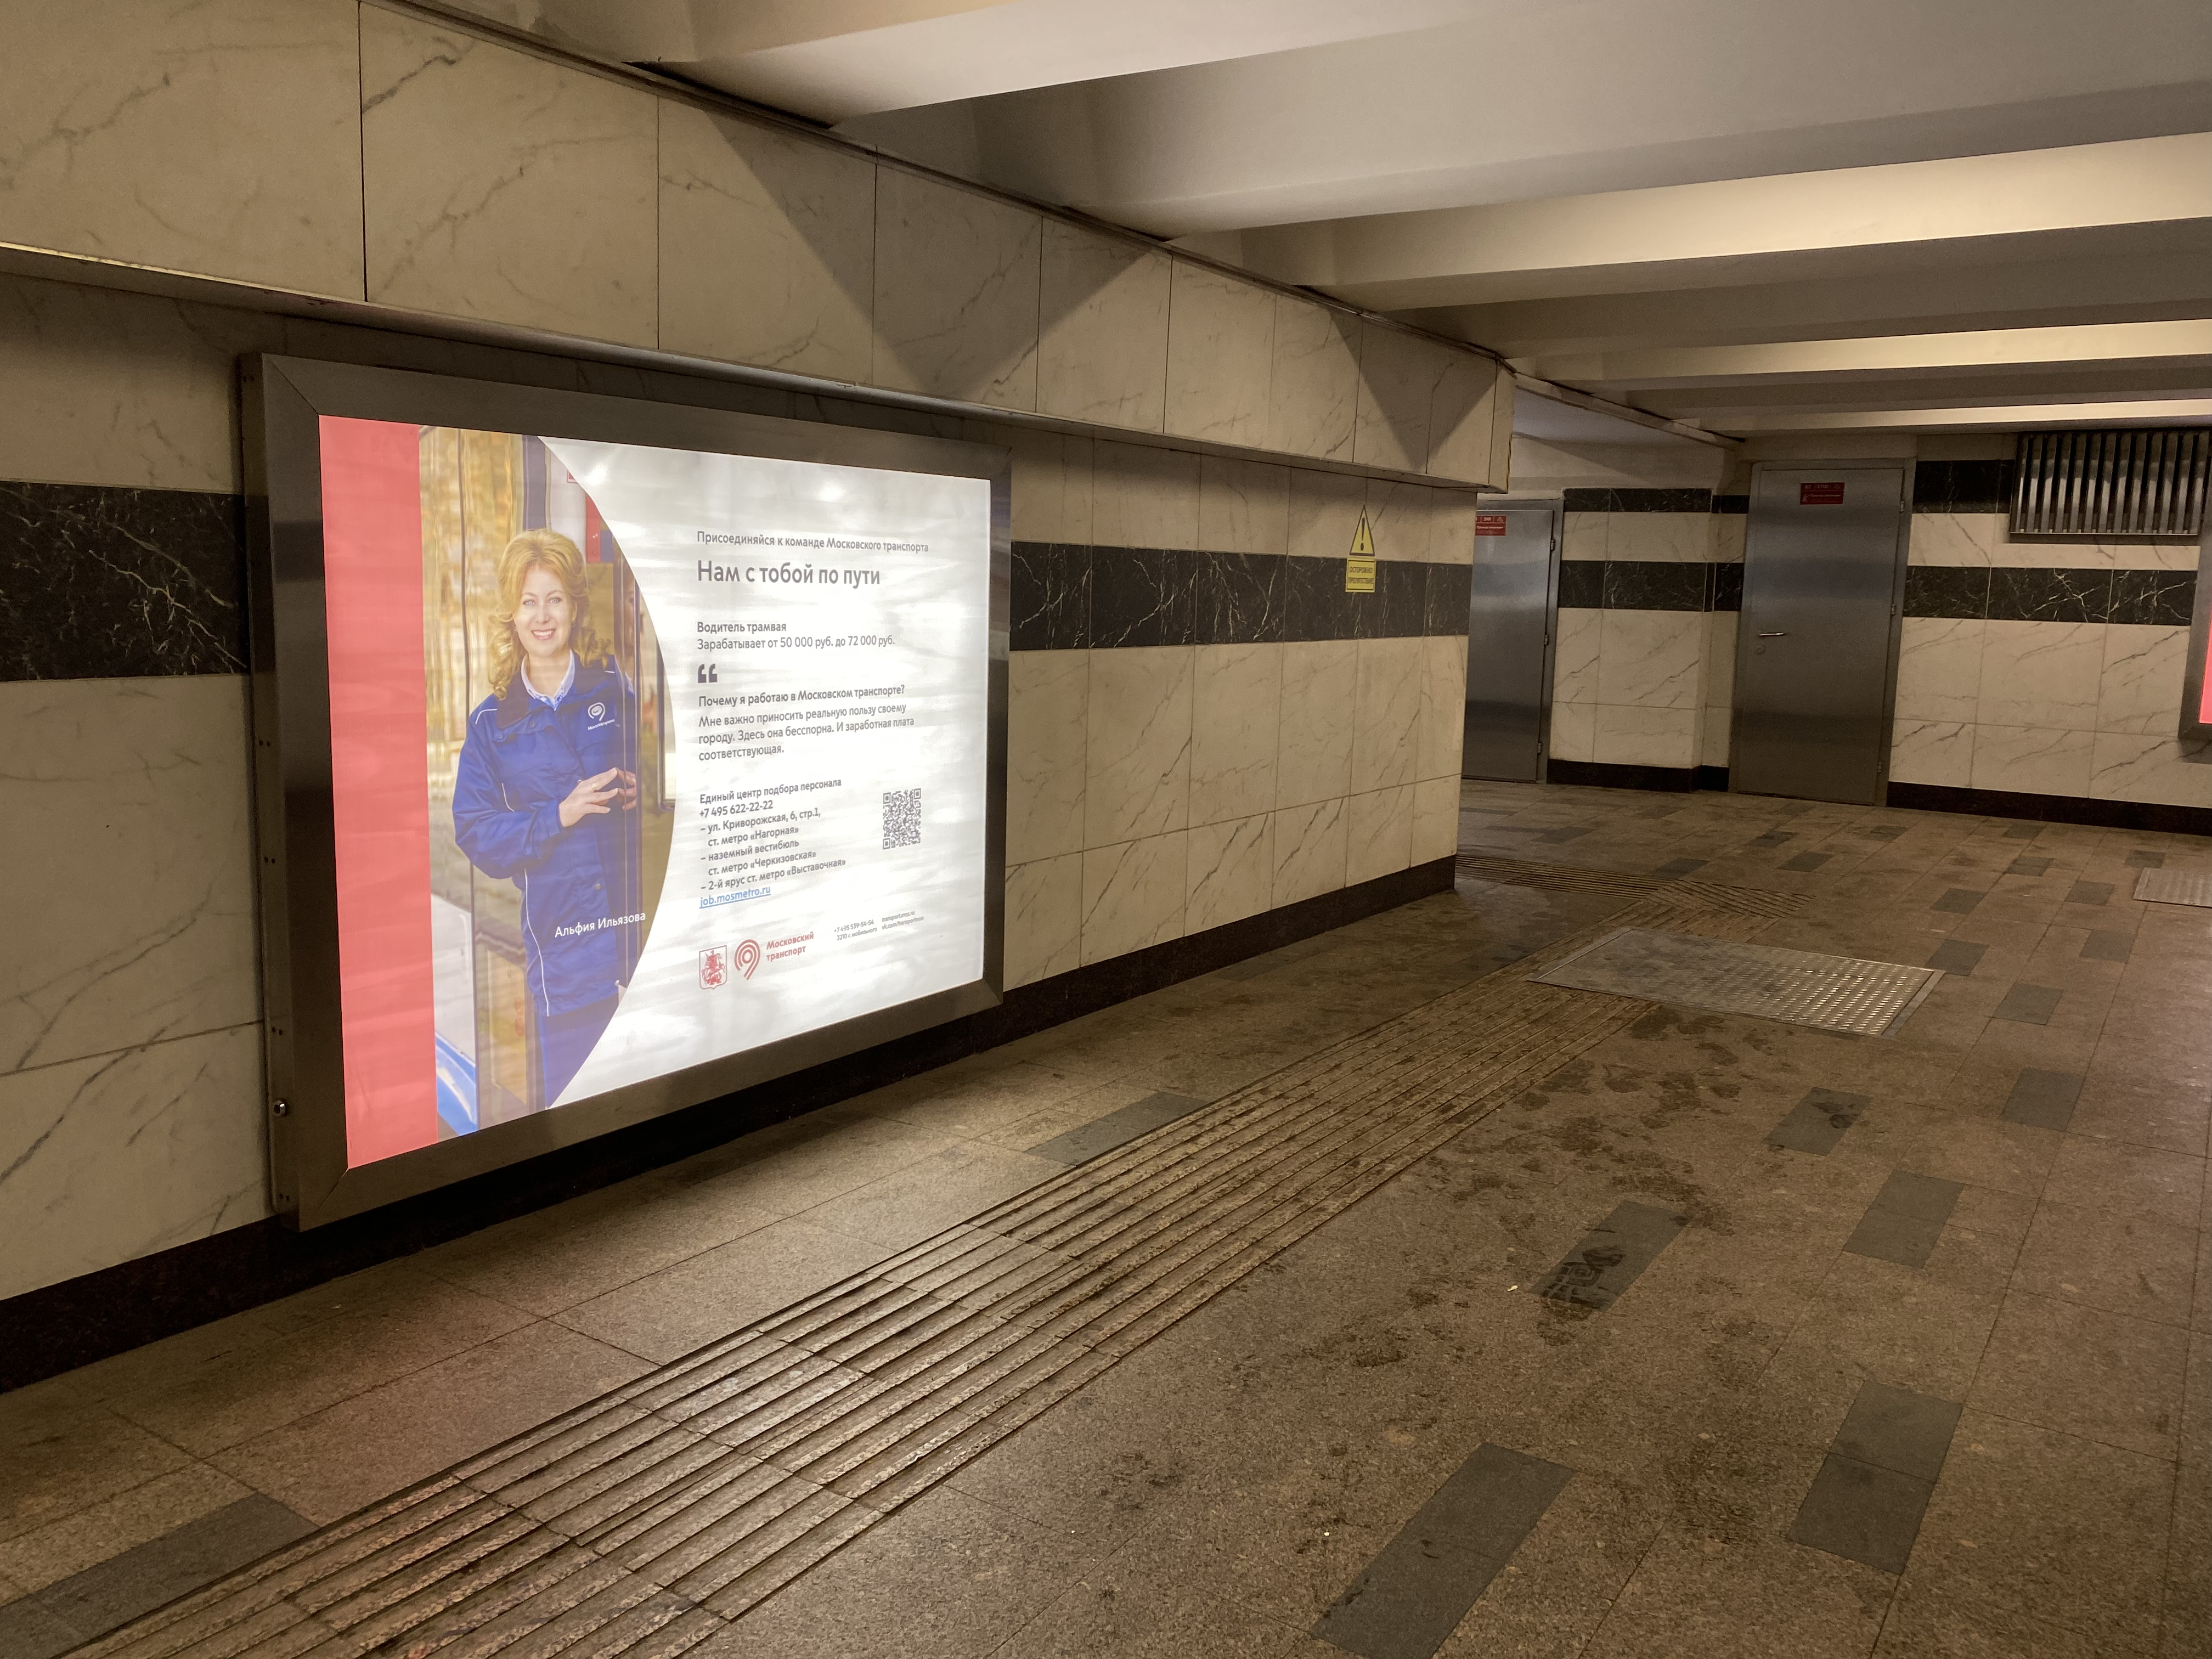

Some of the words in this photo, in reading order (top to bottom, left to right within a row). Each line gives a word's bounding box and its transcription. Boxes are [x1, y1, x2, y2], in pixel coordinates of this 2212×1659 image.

[697, 531, 775, 546] Присоединяйся
[777, 537, 784, 546] к
[785, 538, 825, 550] команде
[826, 537, 882, 550] Московского
[882, 543, 929, 554] транспорта
[697, 560, 741, 583] Нам
[745, 567, 755, 583] с
[759, 562, 814, 584] тобой
[819, 569, 839, 584] по
[843, 569, 880, 589] пути
[697, 621, 746, 635] Водитель
[746, 623, 787, 635] трамвая
[697, 637, 766, 652] Зарабатывает
[768, 640, 778, 648] от
[780, 636, 792, 648] 50
[794, 636, 813, 647] 000
[815, 635, 833, 650] руб.
[835, 638, 846, 648] до
[848, 635, 859, 646] 72
[860, 635, 877, 646] 000
[878, 634, 895, 647] руб.
[698, 696, 738, 708] Почему
[739, 696, 746, 705] я
[748, 692, 789, 707] работаю
[790, 693, 796, 702] в
[797, 690, 853, 701] Московском
[854, 684, 905, 699] транспорте?
[698, 715, 722, 727] Мне
[724, 715, 755, 726] важно
[757, 712, 804, 725] приносить
[805, 708, 848, 721] реальную
[849, 706, 877, 716] пользу
[877, 704, 907, 714] своему
[698, 733, 736, 746] городу.
[737, 730, 765, 742] Здесь
[766, 729, 783, 738] она
[785, 725, 834, 737] бесспорна.
[836, 721, 844, 732] И
[845, 719, 891, 733] заработная
[893, 718, 915, 727] плата
[698, 745, 785, 761] соответствующая.
[699, 790, 735, 805] Единый
[736, 789, 762, 800] центр
[764, 783, 799, 796] подбора
[800, 779, 842, 792] персонала
[699, 808, 710, 818] +7
[710, 805, 728, 817] 495
[729, 799, 774, 815] 622-22-22
[707, 823, 721, 835] ул.
[723, 814, 788, 832] Криворожская,
[789, 810, 798, 821] 6,
[799, 807, 821, 820] стр.1,
[708, 838, 719, 847] ст.
[720, 834, 749, 845] метро
[749, 826, 799, 840] «Нагорная»
[708, 845, 753, 862] наземный
[754, 839, 799, 854] вестибюль
[708, 867, 720, 876] ст.
[721, 862, 749, 874] метро
[749, 851, 817, 868] «Черкизовская»
[708, 878, 723, 890] 2-й
[725, 877, 746, 889] ярус
[746, 874, 758, 883] ст.
[759, 870, 785, 881] метро
[786, 859, 846, 876] «Выставочная»
[698, 886, 771, 909] job.mosmetro.ru
[554, 922, 595, 938] Альфия
[598, 912, 645, 929] Ильязова
[850, 919, 874, 930] 539-54-54
[766, 930, 814, 950] Московский
[766, 946, 806, 963] транспорт
